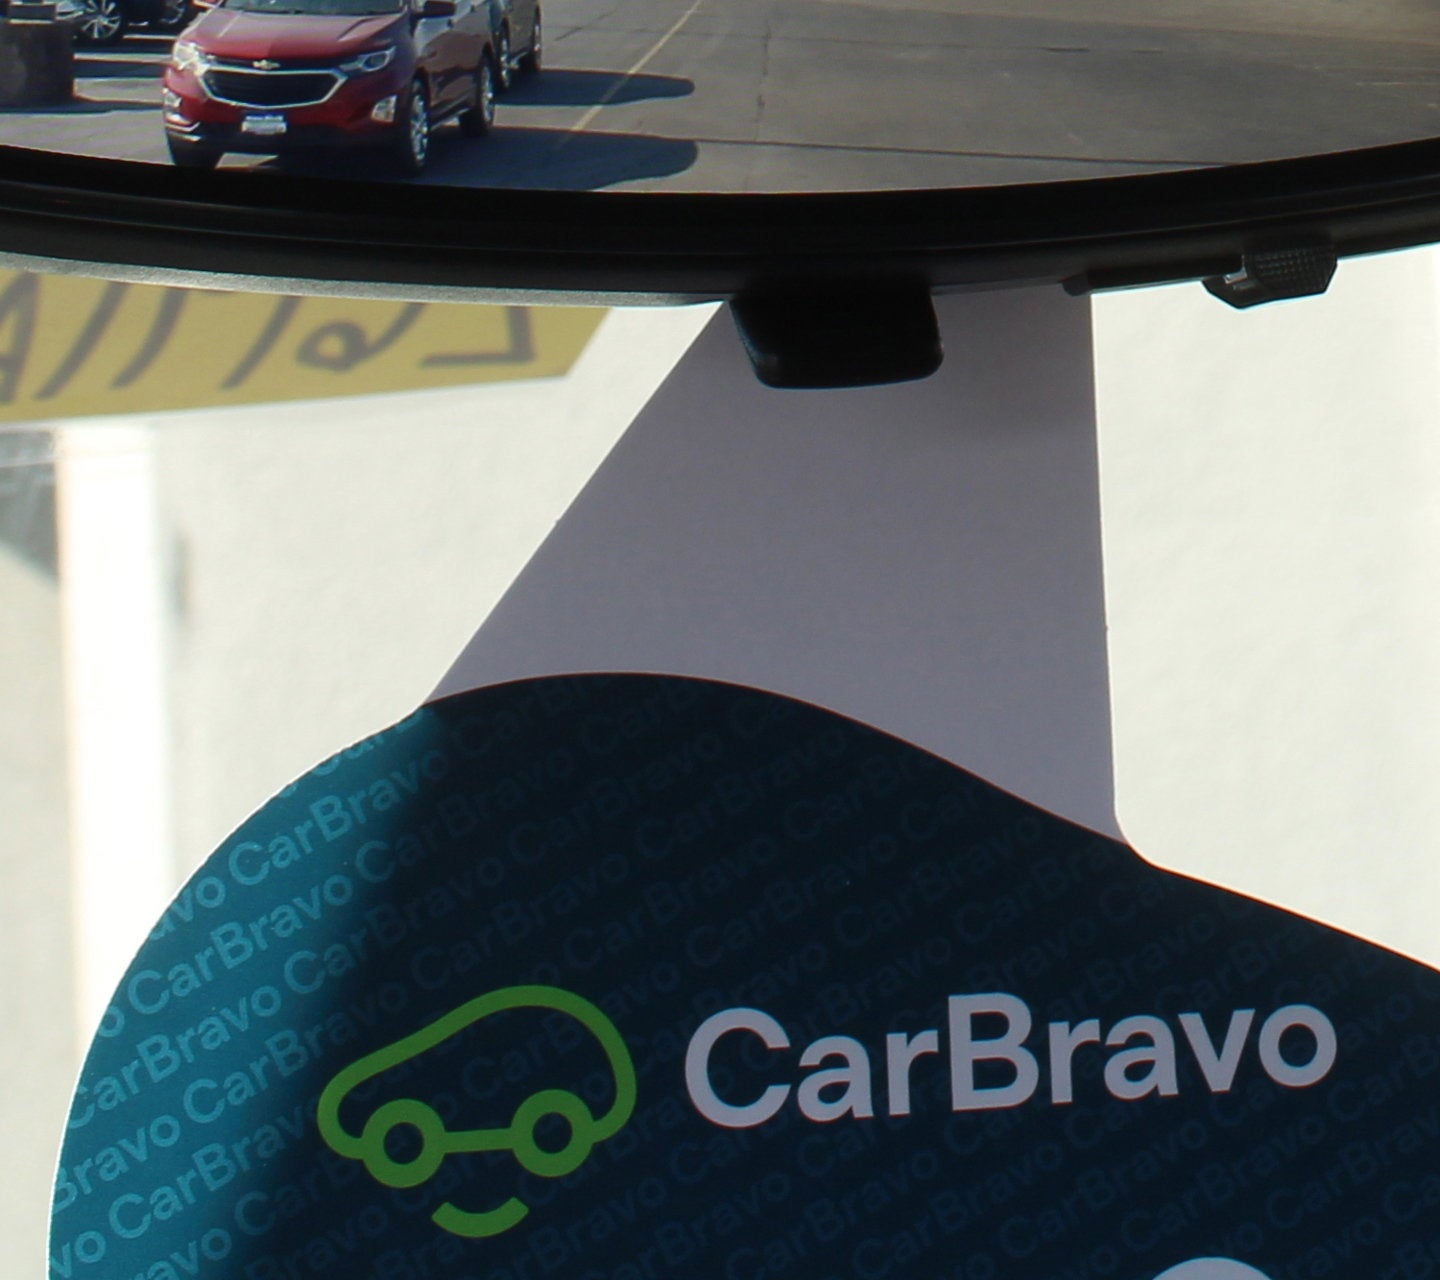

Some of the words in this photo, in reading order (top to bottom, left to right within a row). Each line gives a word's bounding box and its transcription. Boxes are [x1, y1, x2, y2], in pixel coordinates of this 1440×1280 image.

[228, 748, 448, 886] CarBravo
[127, 873, 353, 1014] CarBravo
[684, 992, 1338, 1128] CarBravo
